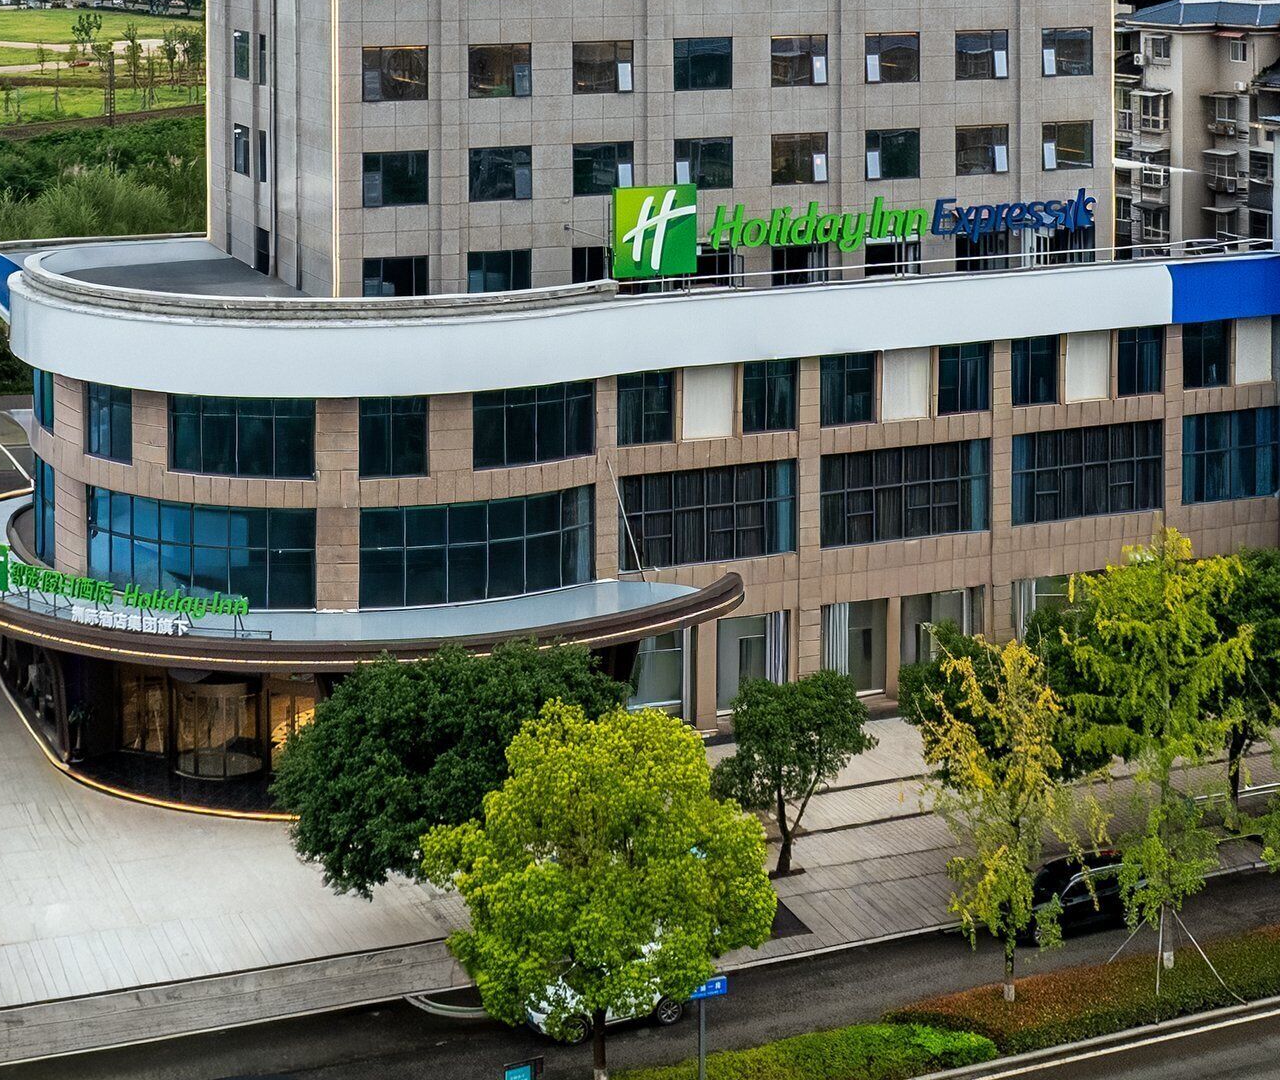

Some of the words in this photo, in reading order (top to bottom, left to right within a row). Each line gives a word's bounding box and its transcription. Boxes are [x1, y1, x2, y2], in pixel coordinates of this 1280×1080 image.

[9, 561, 115, 605] 智选假日酒店
[71, 605, 190, 636] 洲际酒店集团旗下
